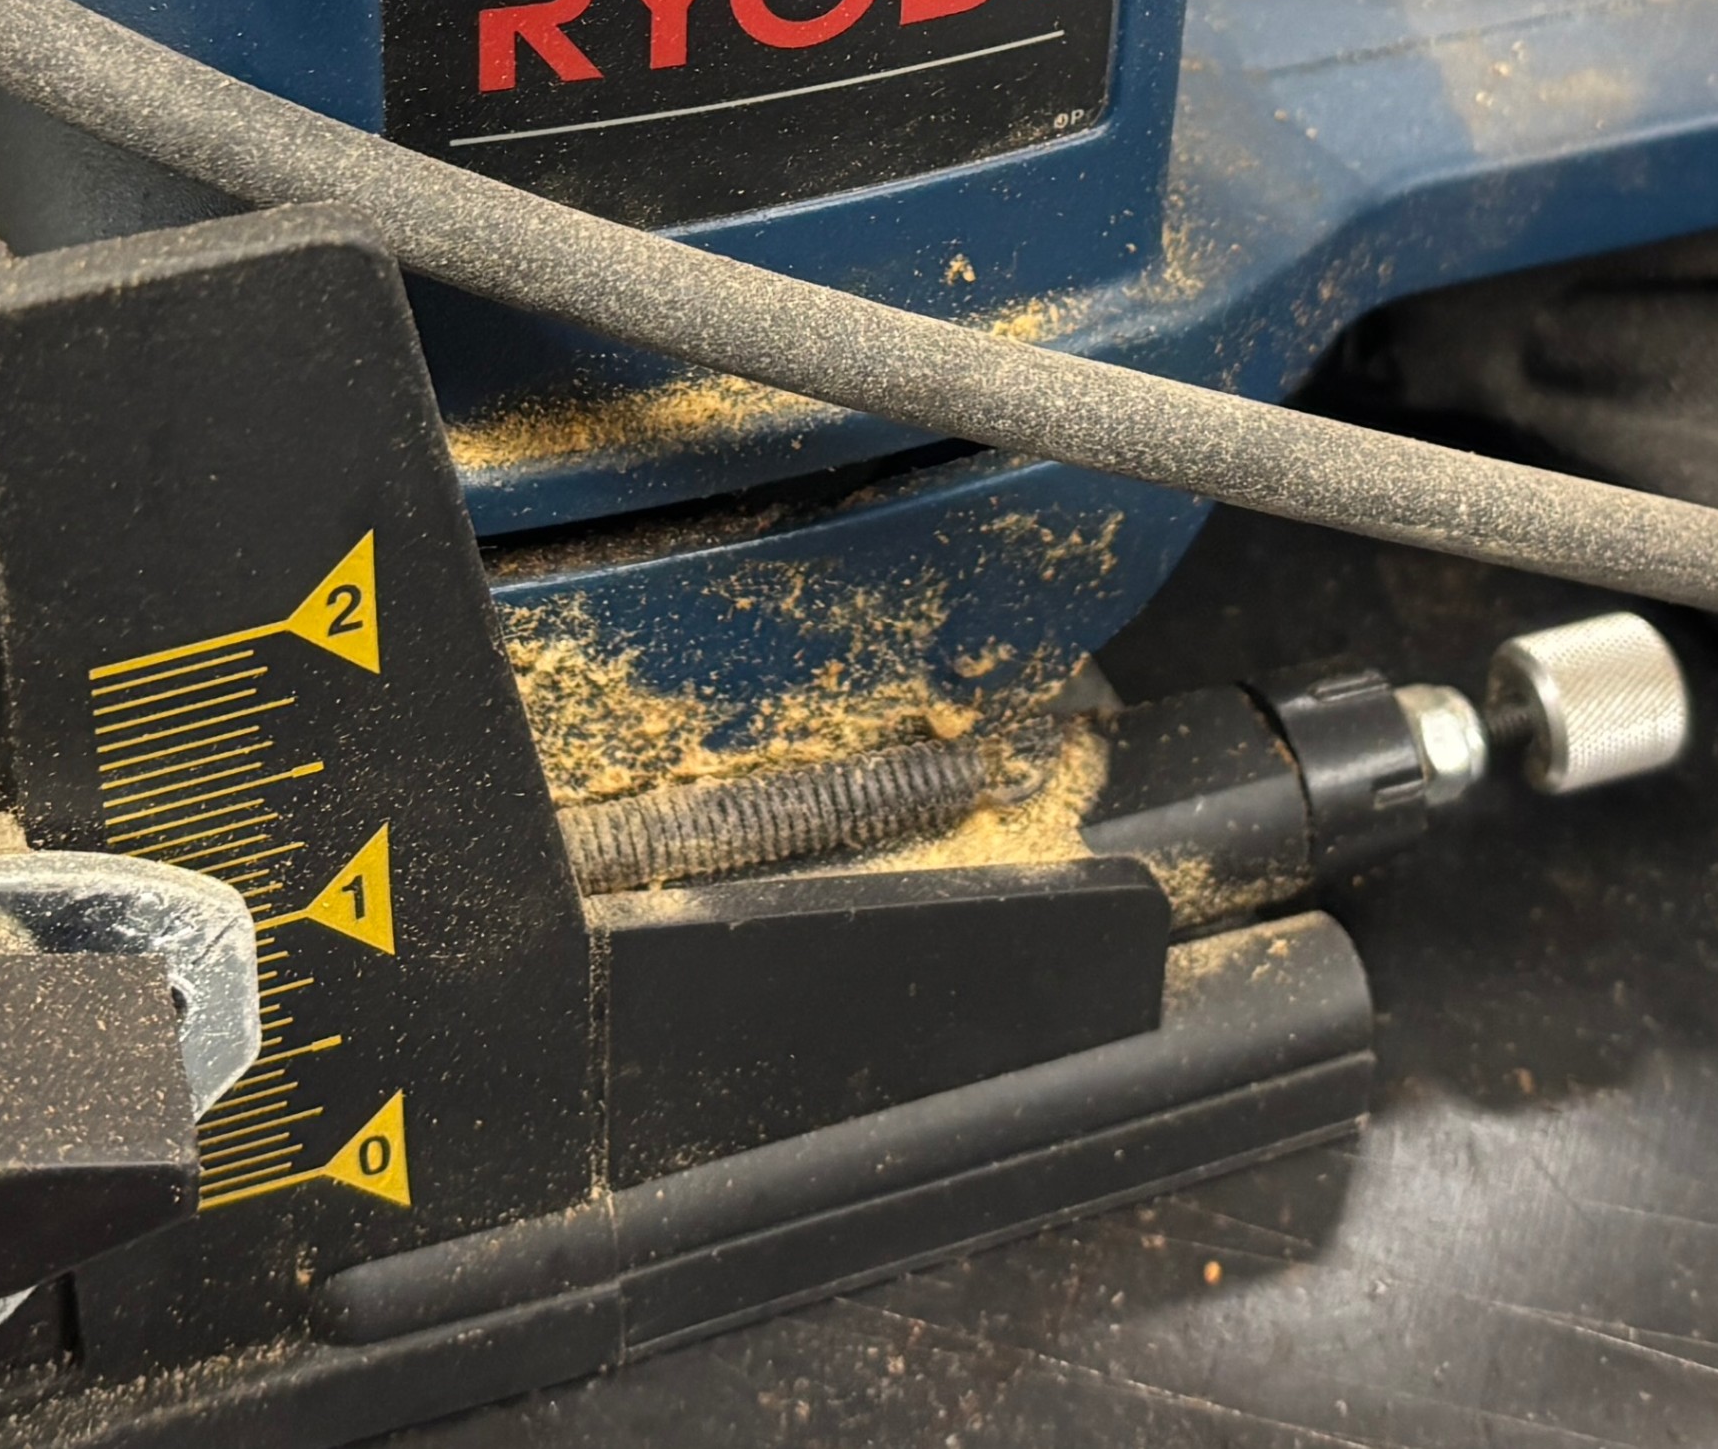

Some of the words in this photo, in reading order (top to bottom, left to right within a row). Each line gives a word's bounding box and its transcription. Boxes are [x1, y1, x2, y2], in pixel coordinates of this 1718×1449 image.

[327, 584, 363, 636] 2
[342, 875, 365, 919] 1
[359, 1136, 391, 1175] 0
